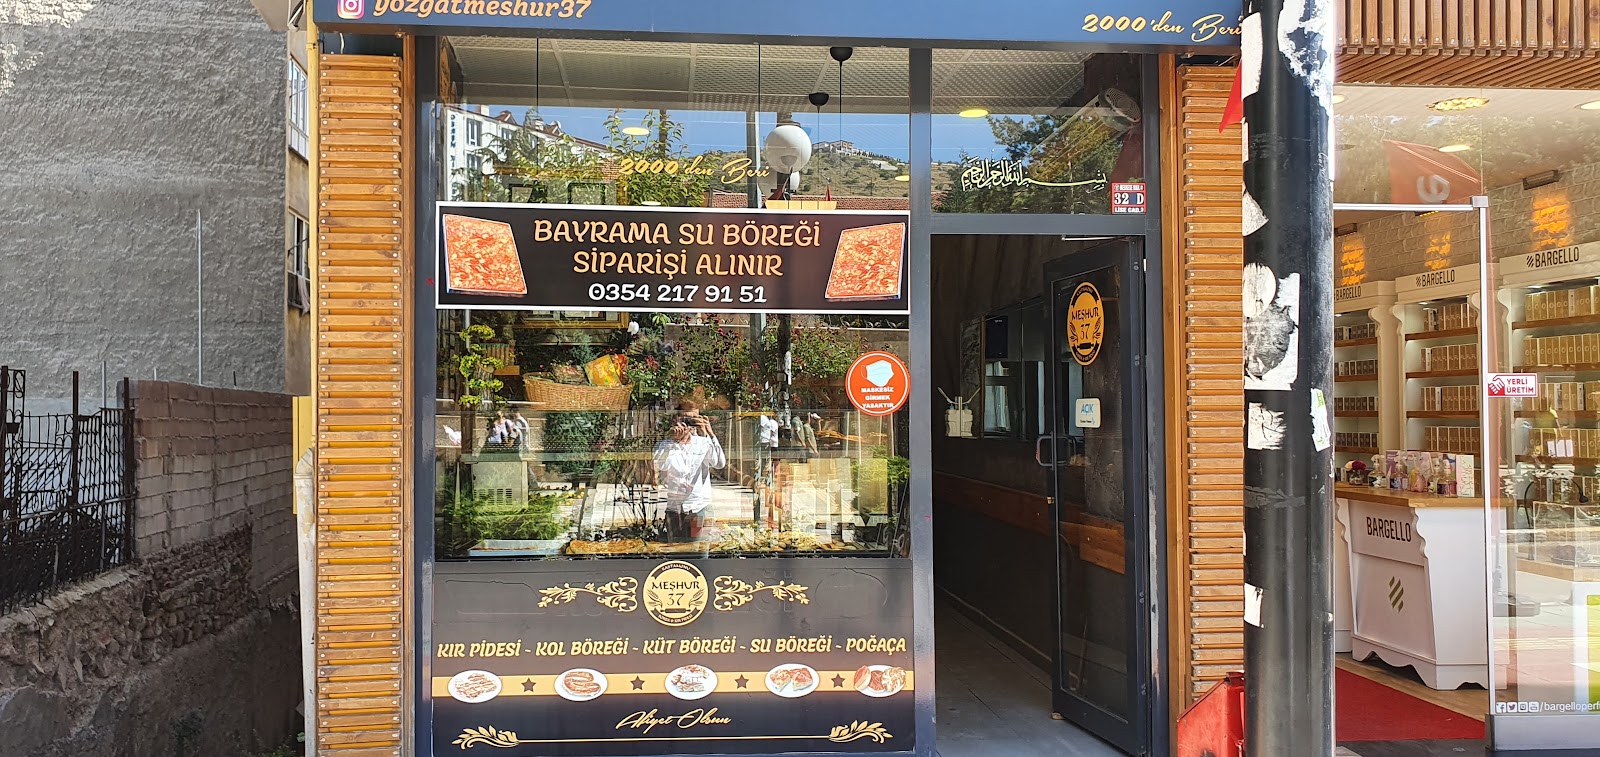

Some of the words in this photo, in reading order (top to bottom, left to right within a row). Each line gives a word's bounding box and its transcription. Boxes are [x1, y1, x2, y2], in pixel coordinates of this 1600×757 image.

[372, 0, 590, 18] yozgatmeshur37
[720, 157, 770, 184] Beri
[1114, 192, 1129, 205] 32
[1136, 192, 1144, 205] D
[533, 219, 671, 244] BAYRAMA
[678, 222, 714, 246] SU
[722, 220, 821, 247] BÖREĞİ
[573, 247, 688, 280] SİPARİŞİ
[695, 253, 784, 276] ALINIR
[1533, 246, 1580, 268] BARGELLO
[1421, 269, 1455, 287] BARGELLO
[588, 282, 651, 302] 0354
[656, 284, 699, 302] 217
[704, 285, 734, 303] 91
[739, 285, 767, 304] 51
[1335, 285, 1361, 300] BARGELLO
[1071, 306, 1099, 321] MEŞHUR
[1080, 323, 1091, 340] 37
[1506, 377, 1528, 385] YERLİ
[1506, 385, 1534, 393] ÜRETİM
[1366, 516, 1411, 542] BARGELLO
[651, 581, 700, 591] MEŞHUR
[666, 592, 685, 606] 37
[436, 643, 466, 658] KIR
[469, 639, 522, 657] PİDESİ
[535, 641, 567, 656] KOL
[570, 637, 630, 656] BÖREĞİ
[642, 637, 676, 655] KÜT
[679, 635, 737, 654] BÖREĞİ
[749, 638, 772, 654] SU
[775, 634, 833, 653] BÖREĞİ
[845, 635, 908, 656] POĞAÇA
[676, 707, 732, 728] Olsun
